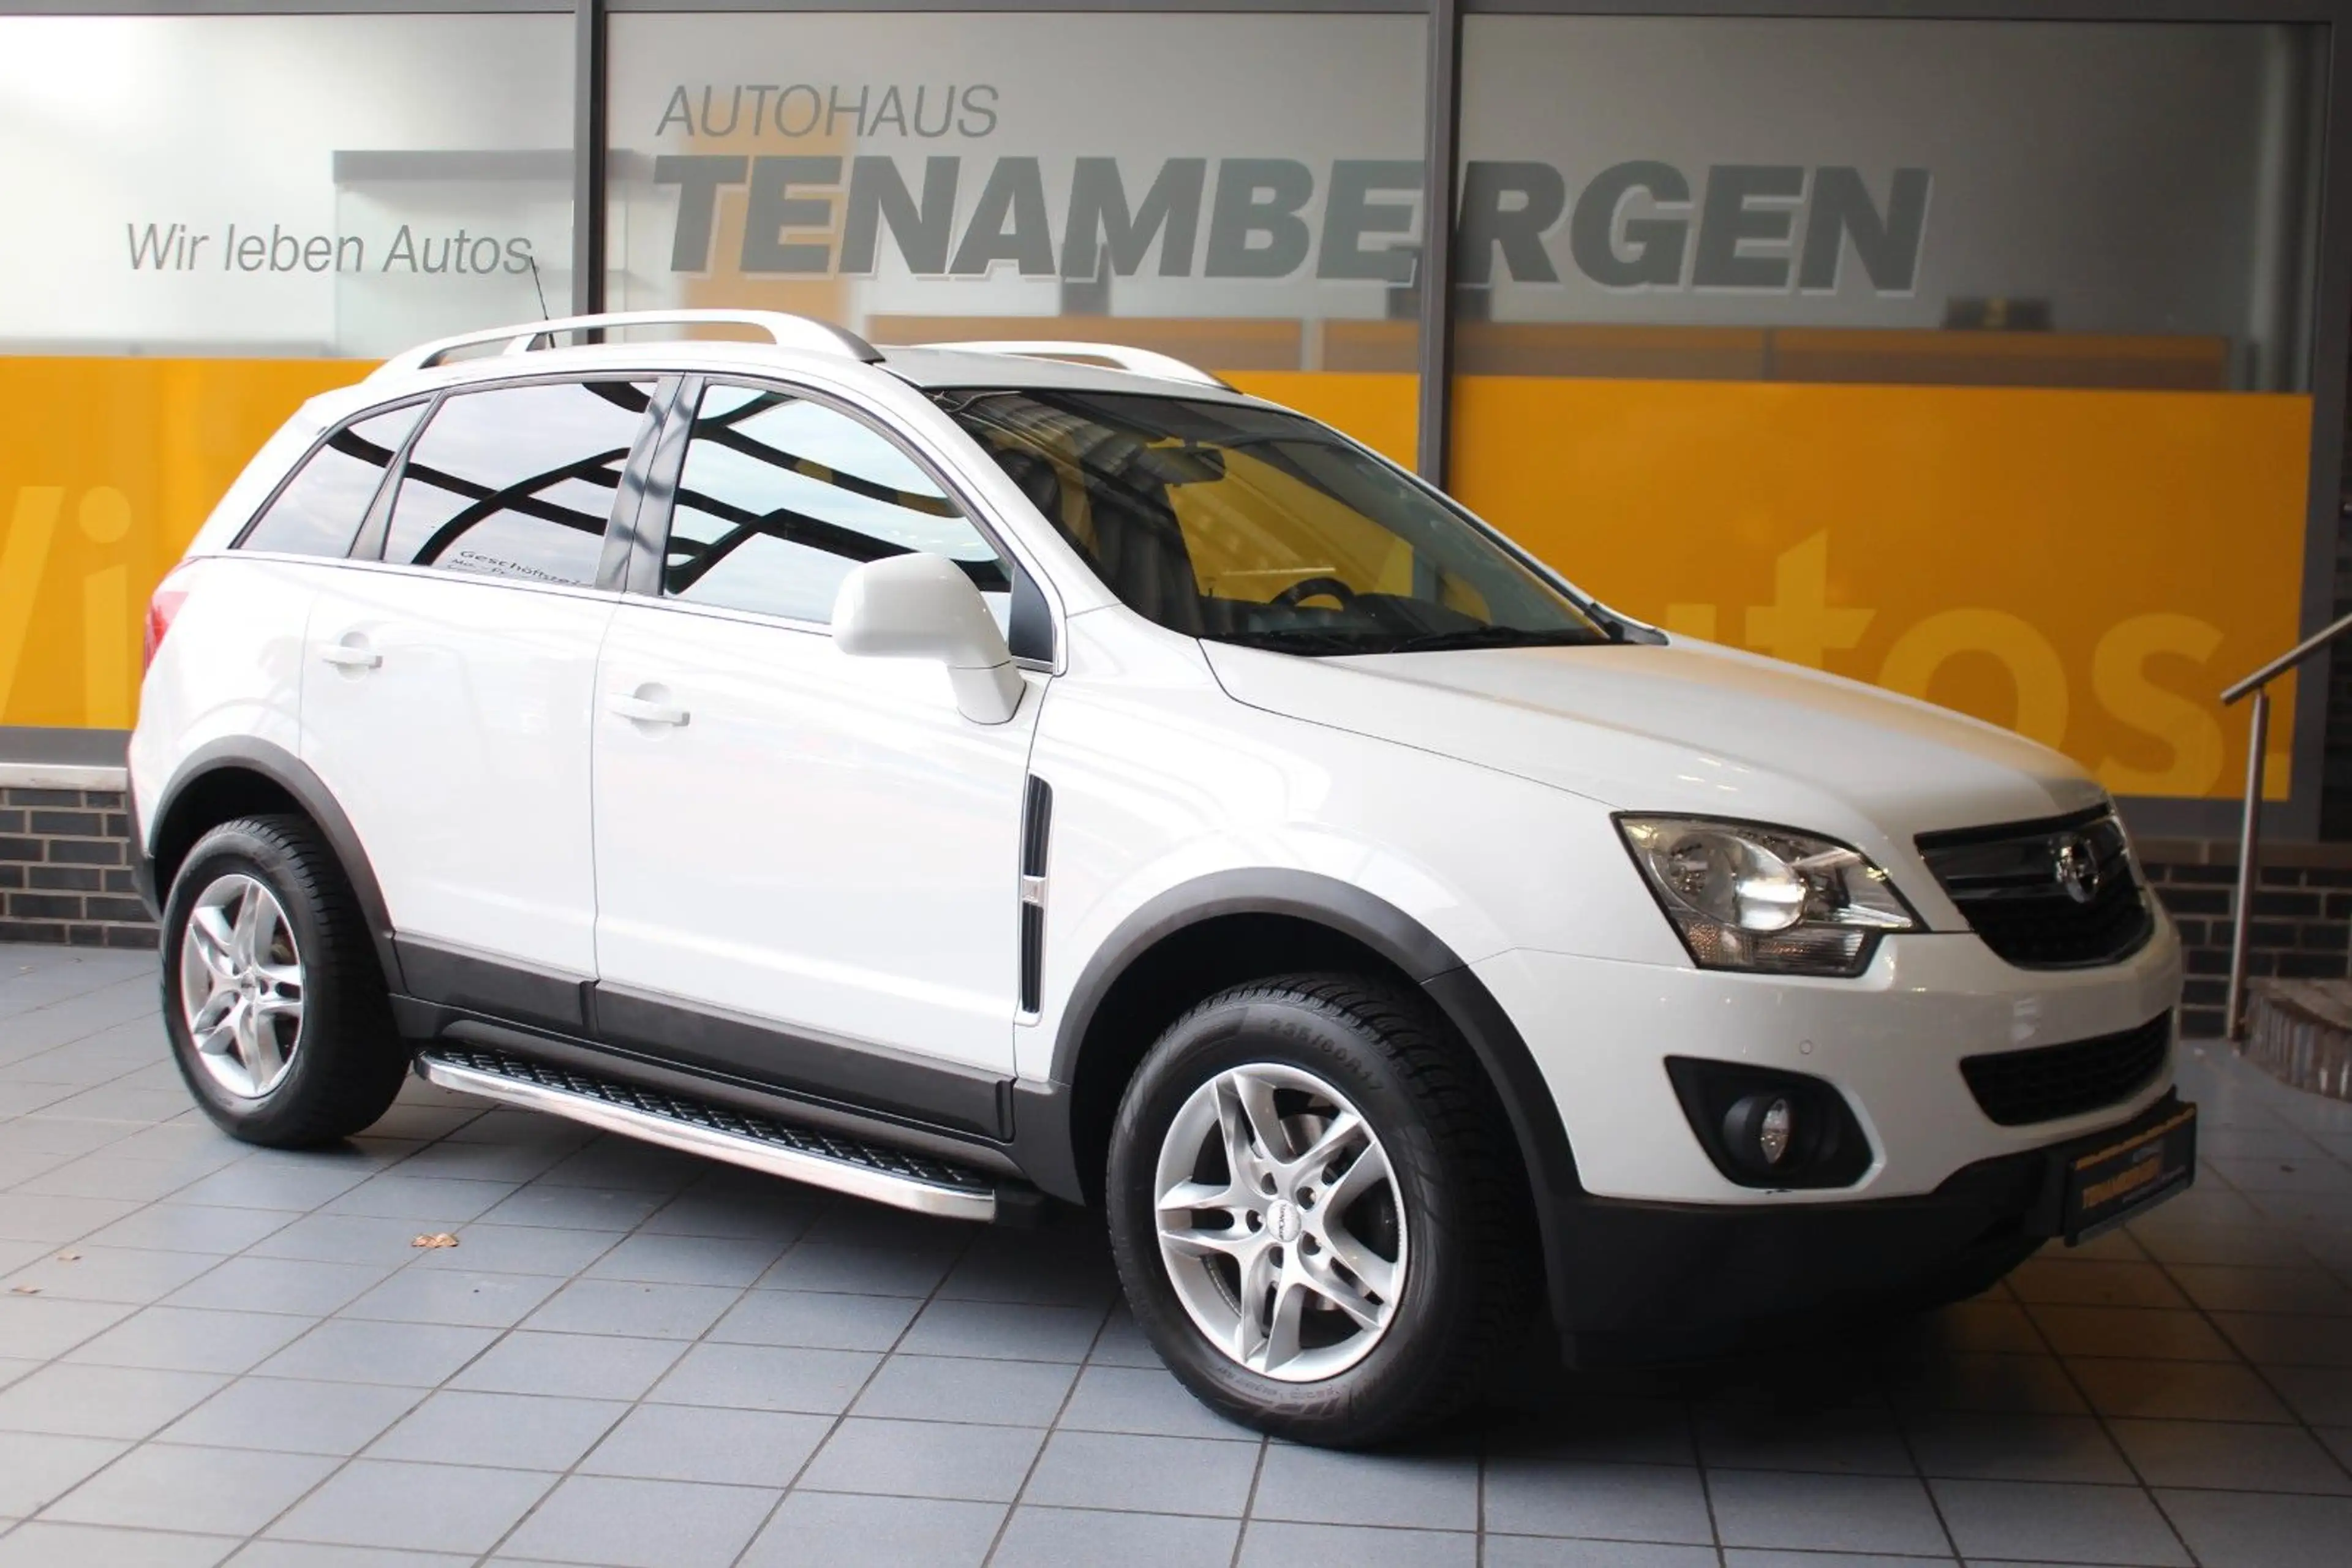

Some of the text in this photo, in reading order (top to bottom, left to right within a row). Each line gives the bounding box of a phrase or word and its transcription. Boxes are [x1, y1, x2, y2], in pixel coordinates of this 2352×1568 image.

[655, 84, 998, 138] AUTOHAUS
[127, 223, 209, 271] Wir
[224, 224, 365, 273] leben
[654, 155, 1932, 295] TENAMBERGEN
